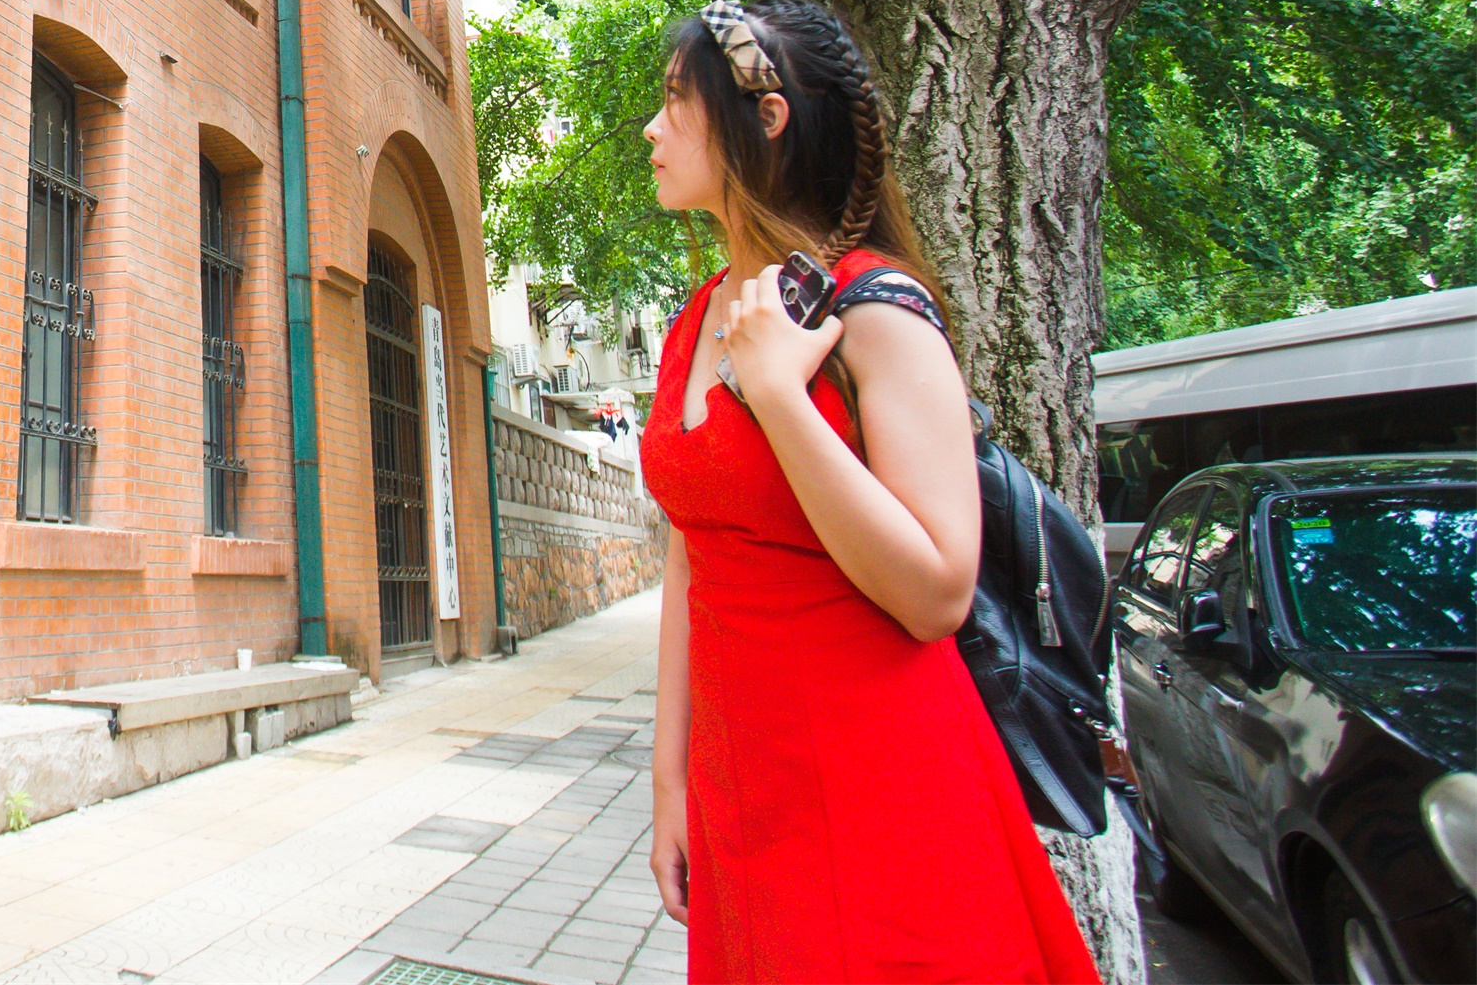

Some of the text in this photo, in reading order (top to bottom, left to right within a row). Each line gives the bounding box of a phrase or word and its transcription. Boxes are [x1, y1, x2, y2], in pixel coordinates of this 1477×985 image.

[431, 317, 457, 610] 青岛当代艺术文献中心
